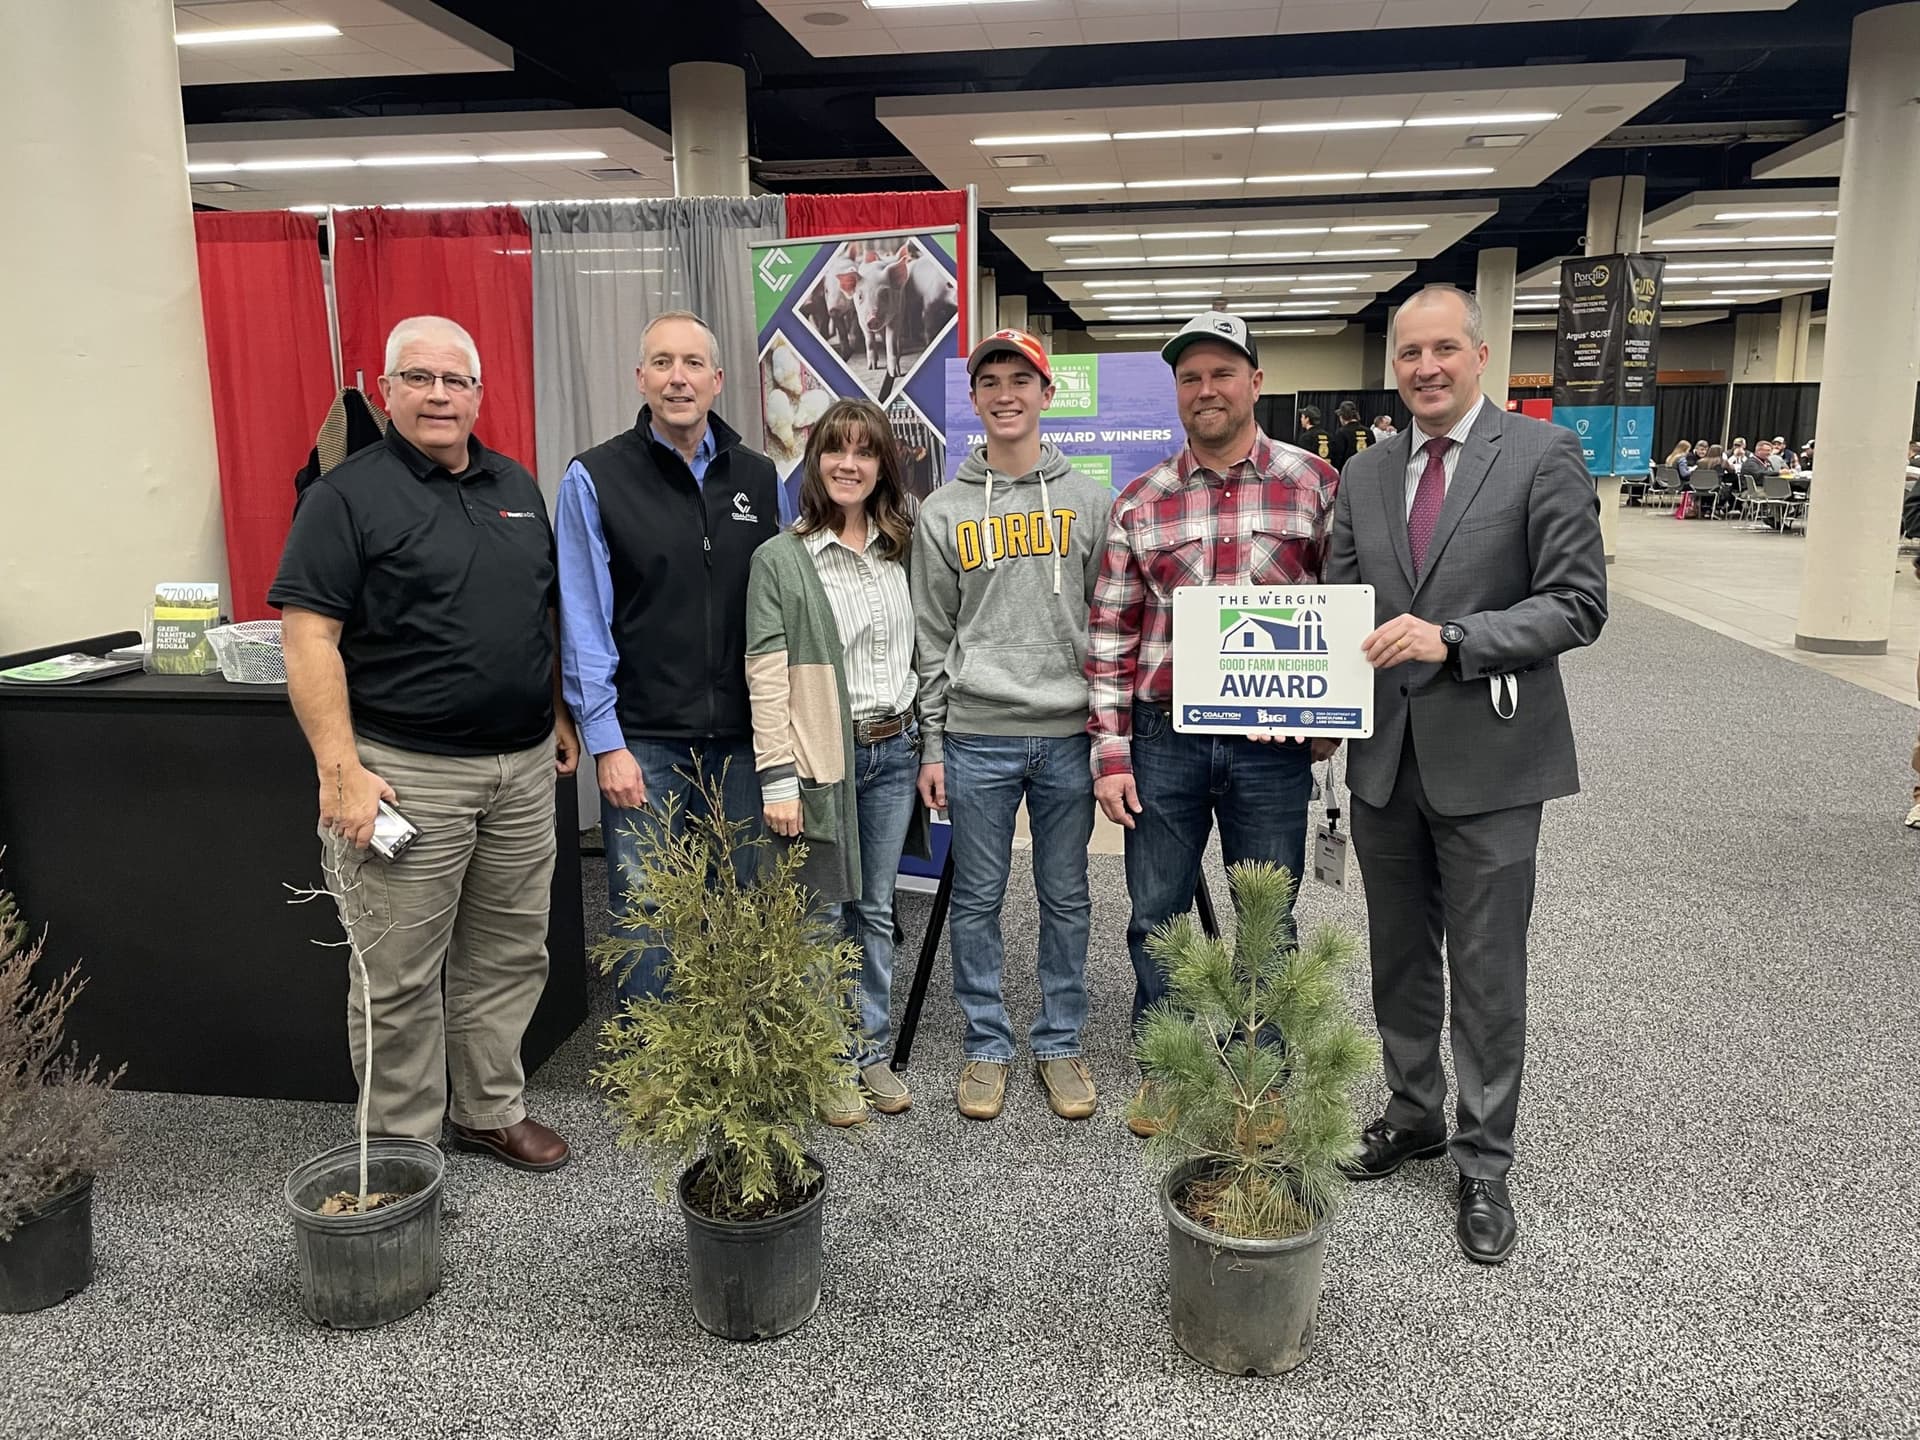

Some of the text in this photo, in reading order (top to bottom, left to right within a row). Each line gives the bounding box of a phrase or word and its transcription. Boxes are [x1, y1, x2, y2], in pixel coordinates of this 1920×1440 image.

[1574, 271, 1606, 282] Porcilis
[1633, 278, 1656, 295] GUTS
[1628, 308, 1656, 326] GLORY
[1040, 432, 1096, 443] AWARD
[1100, 429, 1172, 442] WINNERS
[1218, 594, 1327, 605] THE WERGIN
[1219, 658, 1328, 672] GOOD FARM NEIGHBOR
[1220, 674, 1328, 699] AWARD
